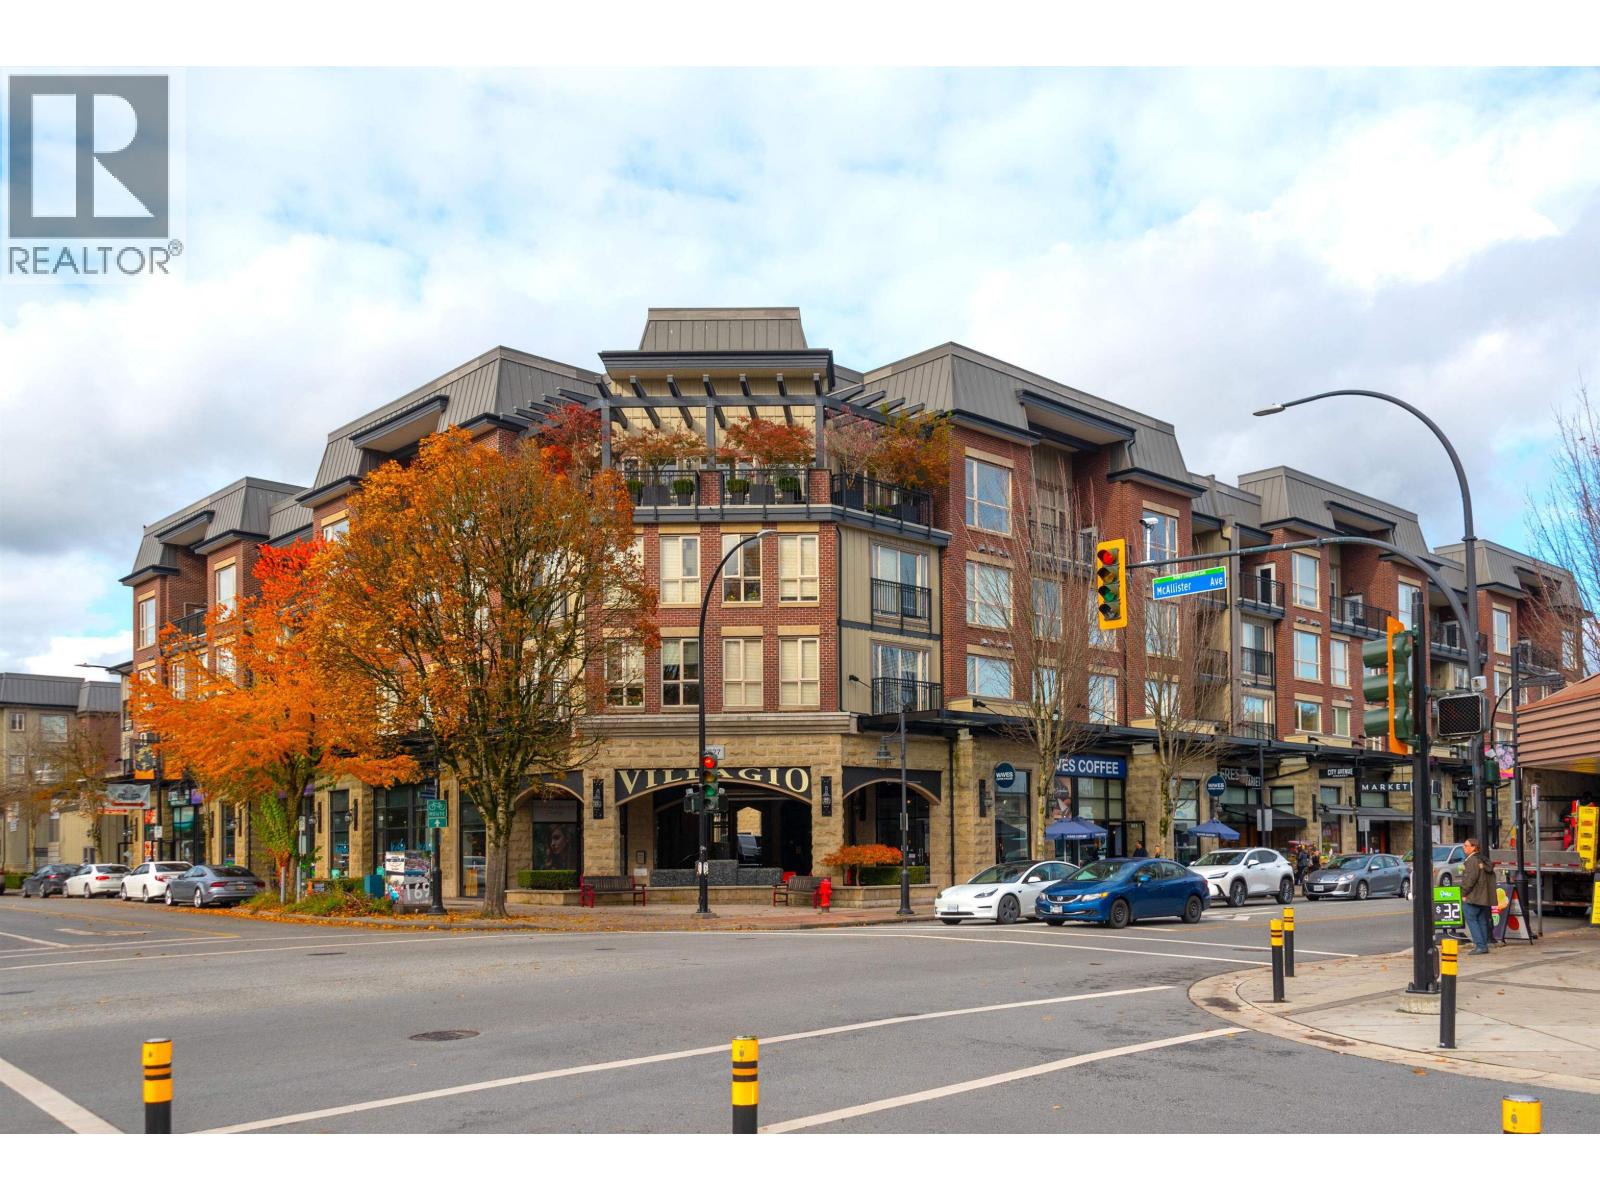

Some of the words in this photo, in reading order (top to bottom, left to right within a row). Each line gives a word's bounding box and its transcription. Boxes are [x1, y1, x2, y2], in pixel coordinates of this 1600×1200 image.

[1157, 582, 1192, 595] McAllister
[1210, 576, 1223, 587] Ave
[1078, 759, 1119, 775] COFFEE
[1361, 783, 1408, 791] MARKET
[406, 882, 430, 901] 169
[1443, 903, 1460, 919] 32
